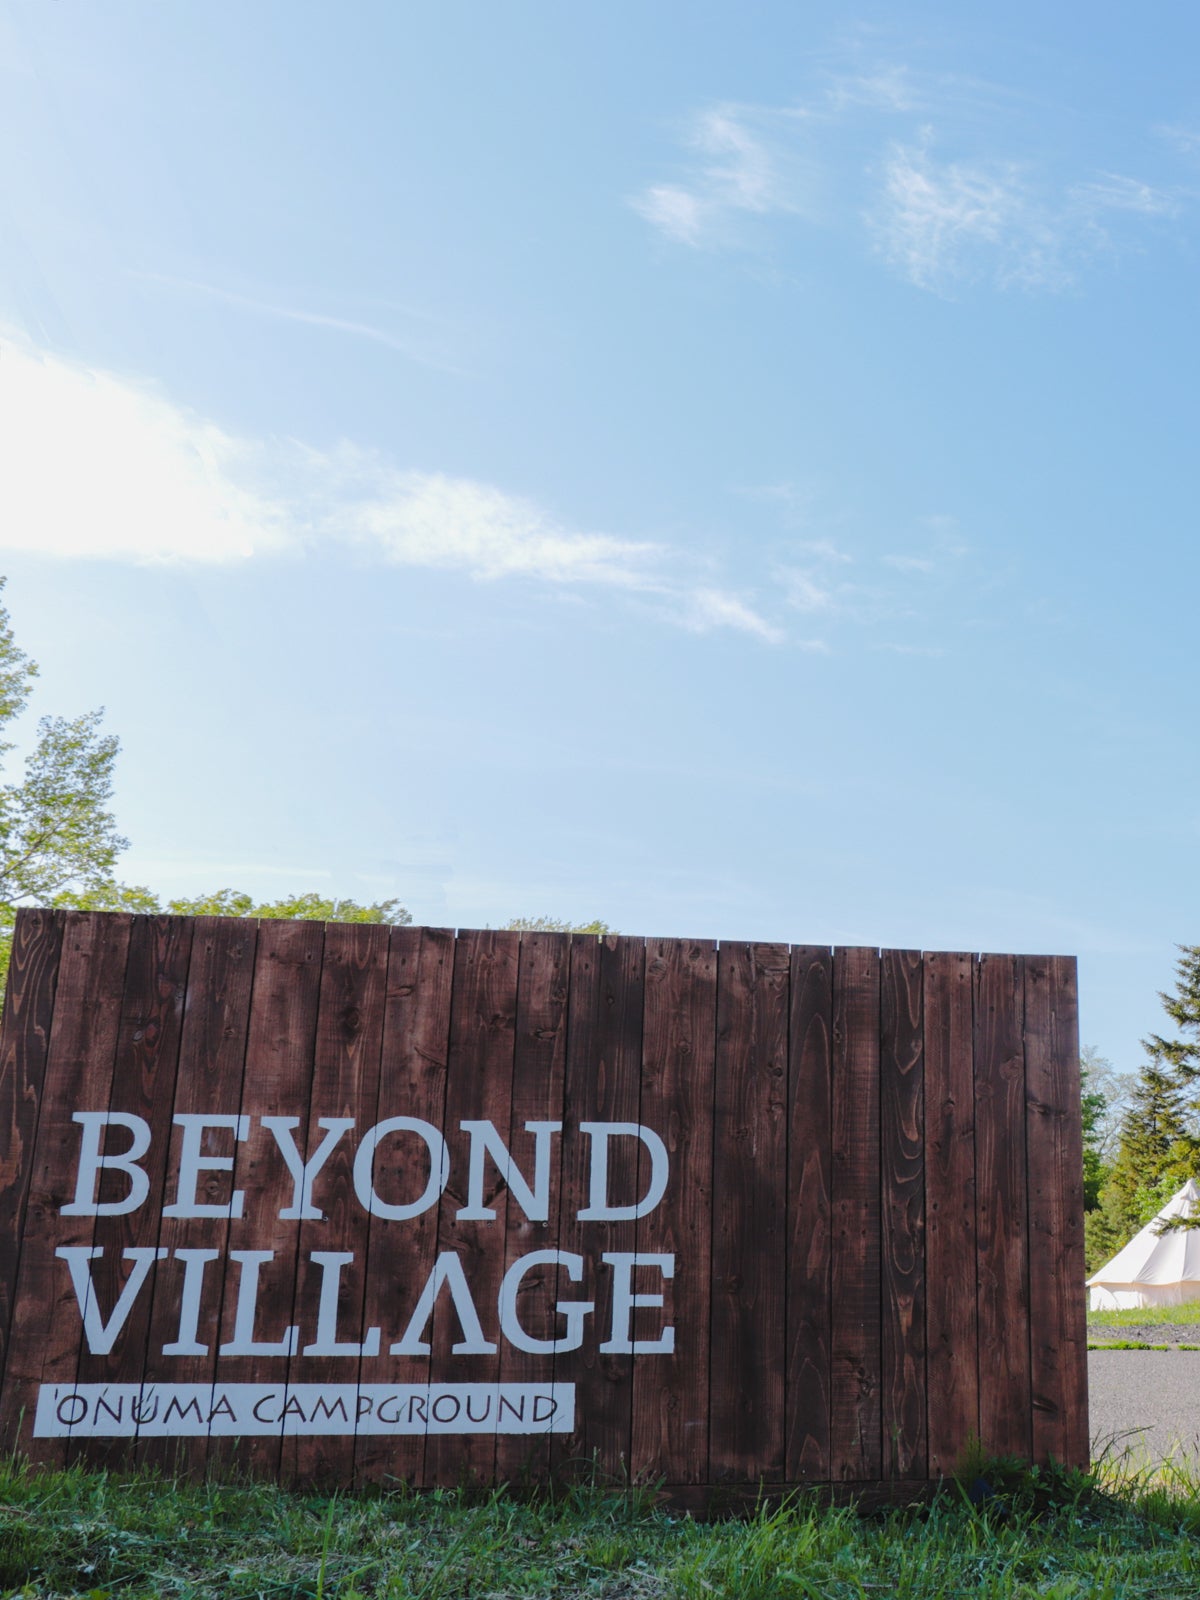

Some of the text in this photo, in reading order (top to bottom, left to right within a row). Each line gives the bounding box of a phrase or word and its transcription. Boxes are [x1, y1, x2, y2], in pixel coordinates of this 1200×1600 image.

[59, 1111, 670, 1221] BEYOND
[55, 1246, 675, 1356] VILLAGE
[56, 1394, 559, 1426] ONUMA CAMPGROUND
